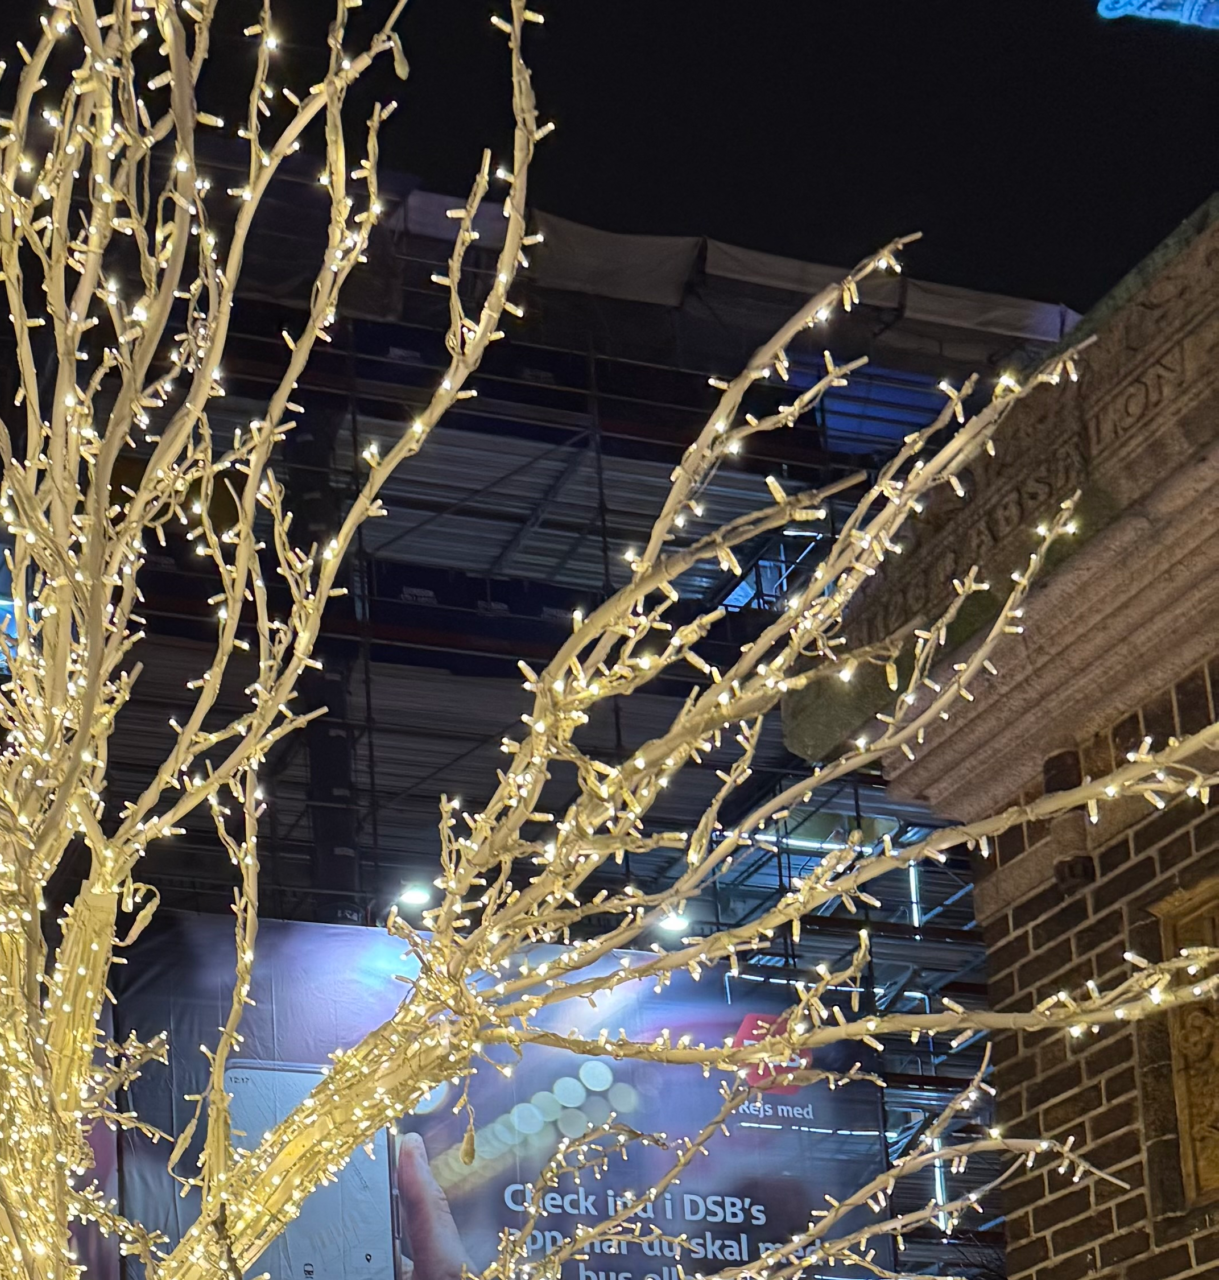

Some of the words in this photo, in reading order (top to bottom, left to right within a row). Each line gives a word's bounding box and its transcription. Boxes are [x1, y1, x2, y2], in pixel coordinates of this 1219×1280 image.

[739, 1100, 773, 1119] Rejs
[778, 1103, 814, 1120] med
[504, 1183, 598, 1216] Check
[663, 1192, 673, 1220] i
[683, 1193, 767, 1226] DSB's
[690, 1231, 749, 1262] skal
